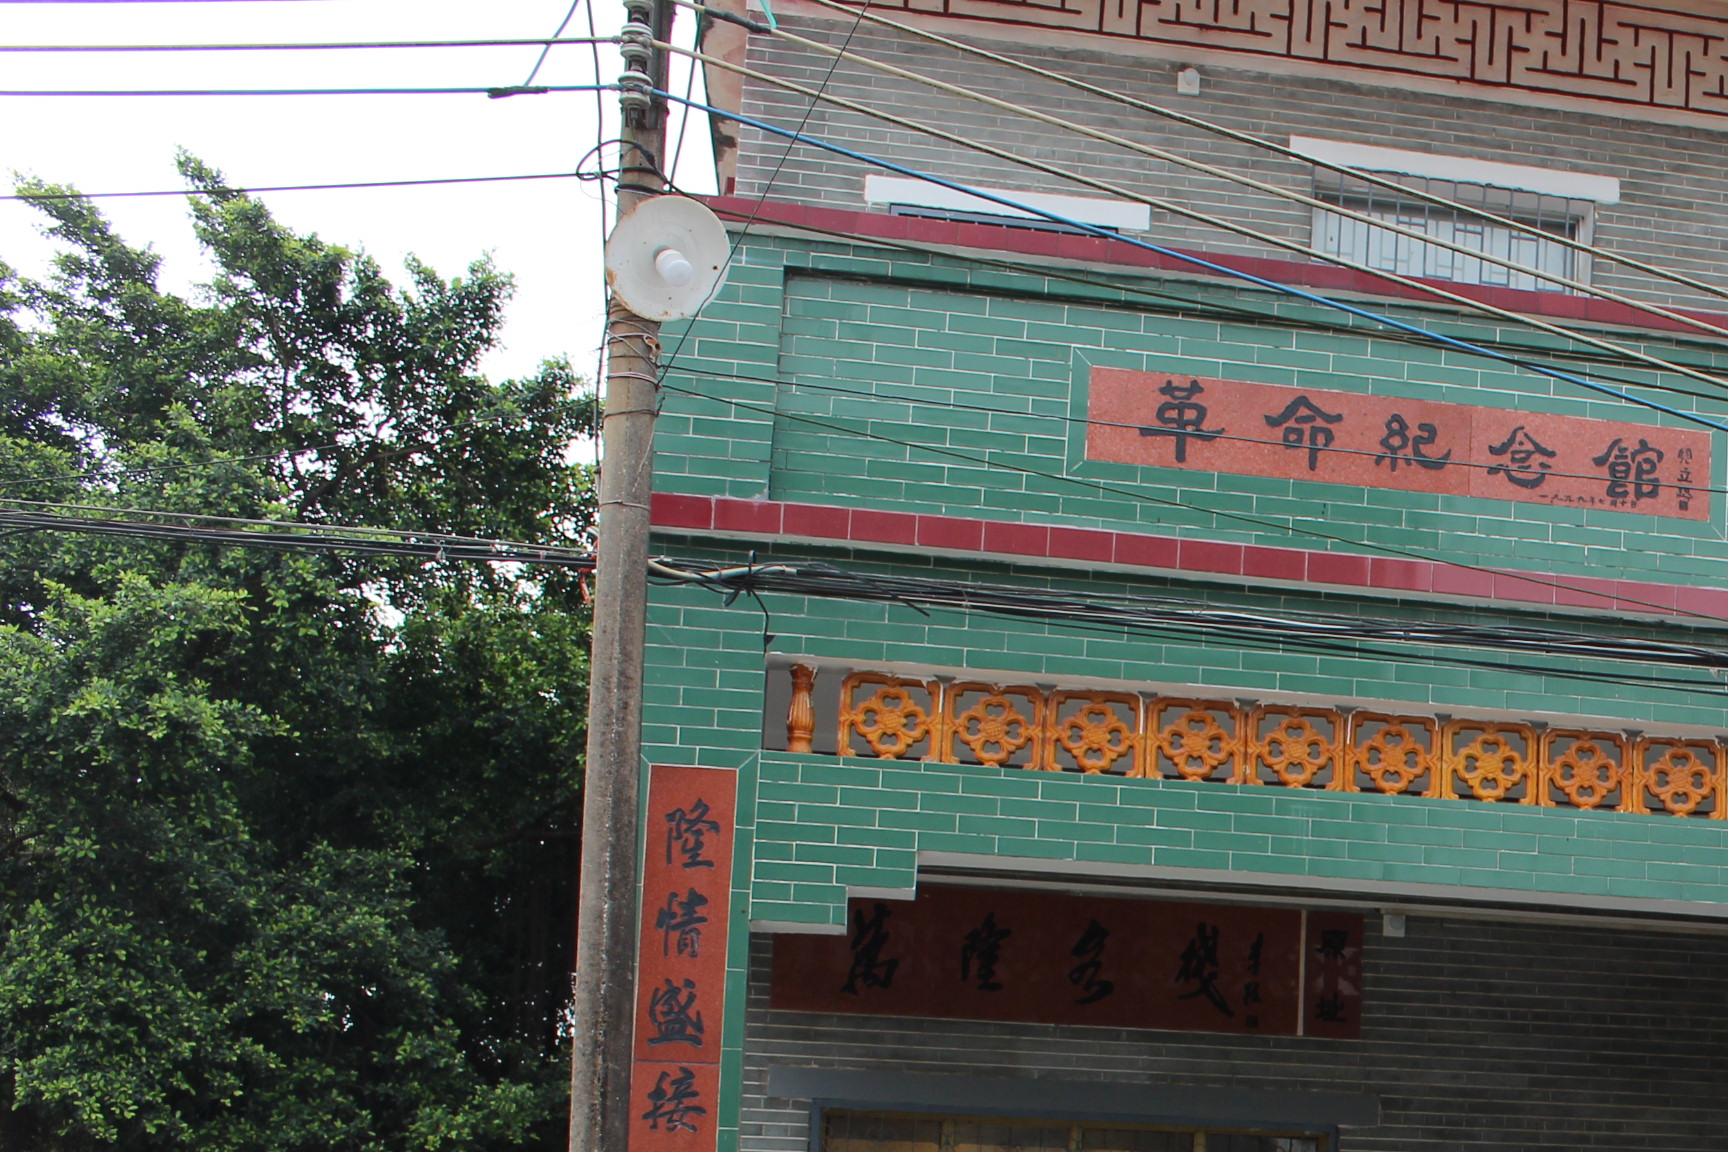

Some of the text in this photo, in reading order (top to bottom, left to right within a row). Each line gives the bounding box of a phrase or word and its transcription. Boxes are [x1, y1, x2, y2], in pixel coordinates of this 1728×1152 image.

[1138, 378, 1665, 500] 革命紀念館
